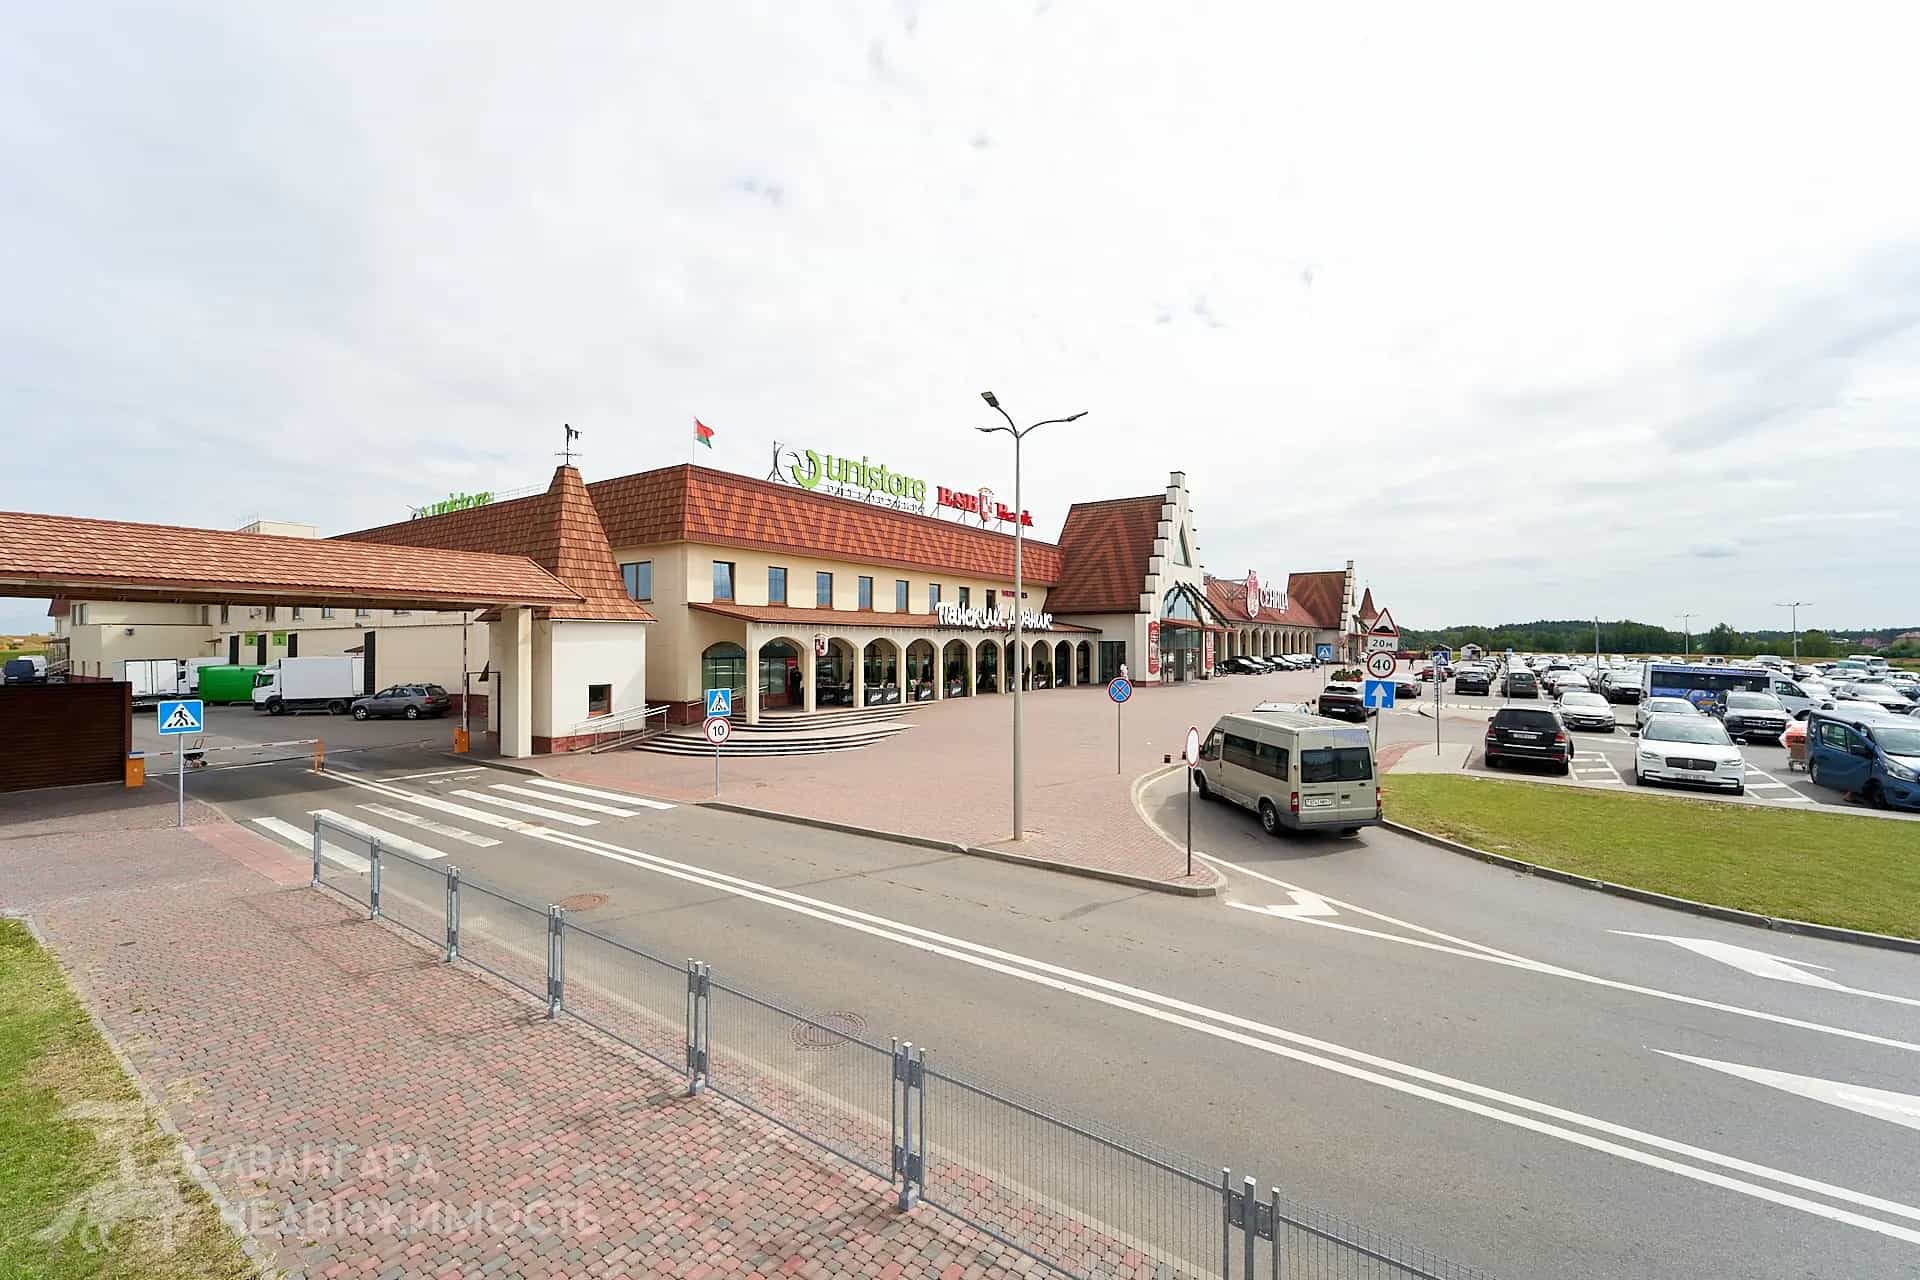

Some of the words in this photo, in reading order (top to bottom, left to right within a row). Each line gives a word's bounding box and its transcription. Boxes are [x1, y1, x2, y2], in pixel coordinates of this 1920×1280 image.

[826, 455, 927, 502] unistore
[936, 486, 979, 514] BSB
[1372, 639, 1385, 648] 20
[1372, 659, 1391, 671] 40
[712, 725, 725, 737] 10
